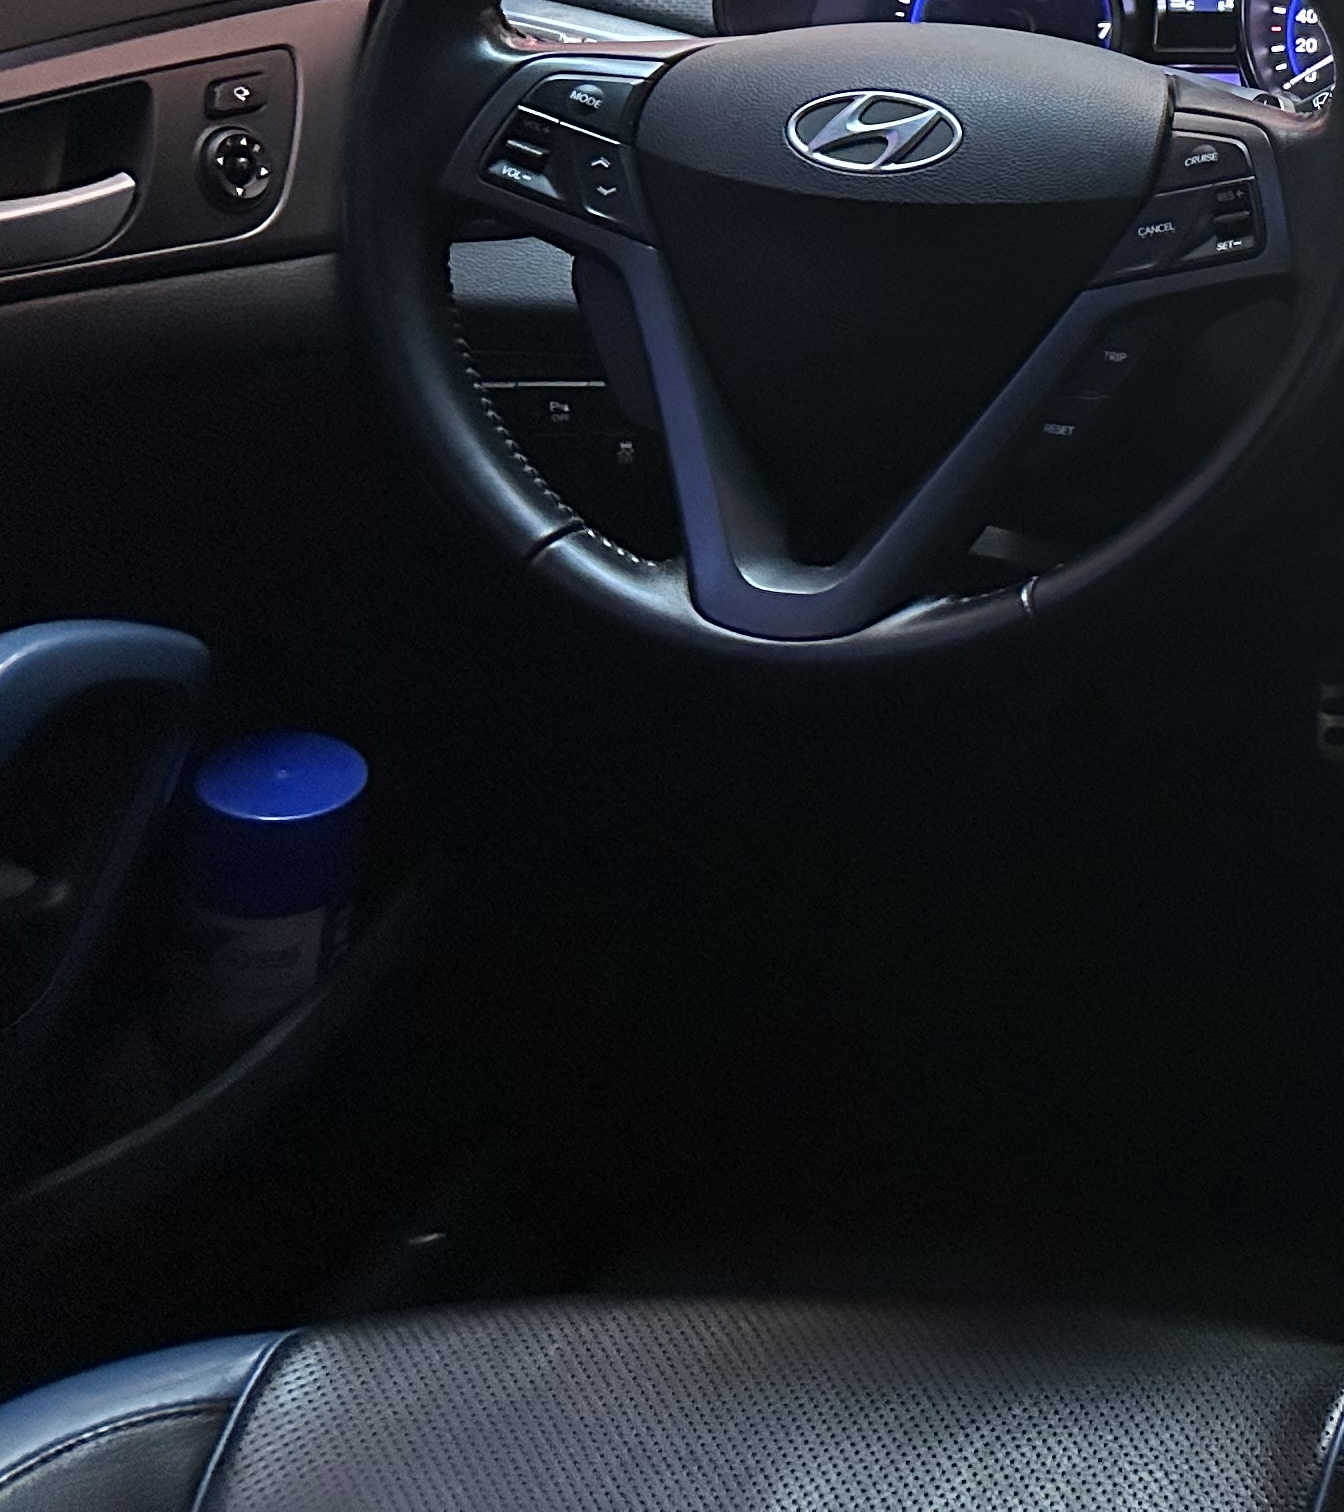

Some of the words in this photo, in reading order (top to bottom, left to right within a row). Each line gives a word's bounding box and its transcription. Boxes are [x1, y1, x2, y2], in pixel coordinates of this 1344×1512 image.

[1295, 9, 1318, 24] 40
[1097, 22, 1111, 39] 7
[1295, 38, 1318, 53] 20
[569, 90, 603, 109] MODE
[1184, 152, 1219, 167] CRUISE
[1137, 222, 1175, 236] CANCEL
[1043, 423, 1075, 436] RESET
